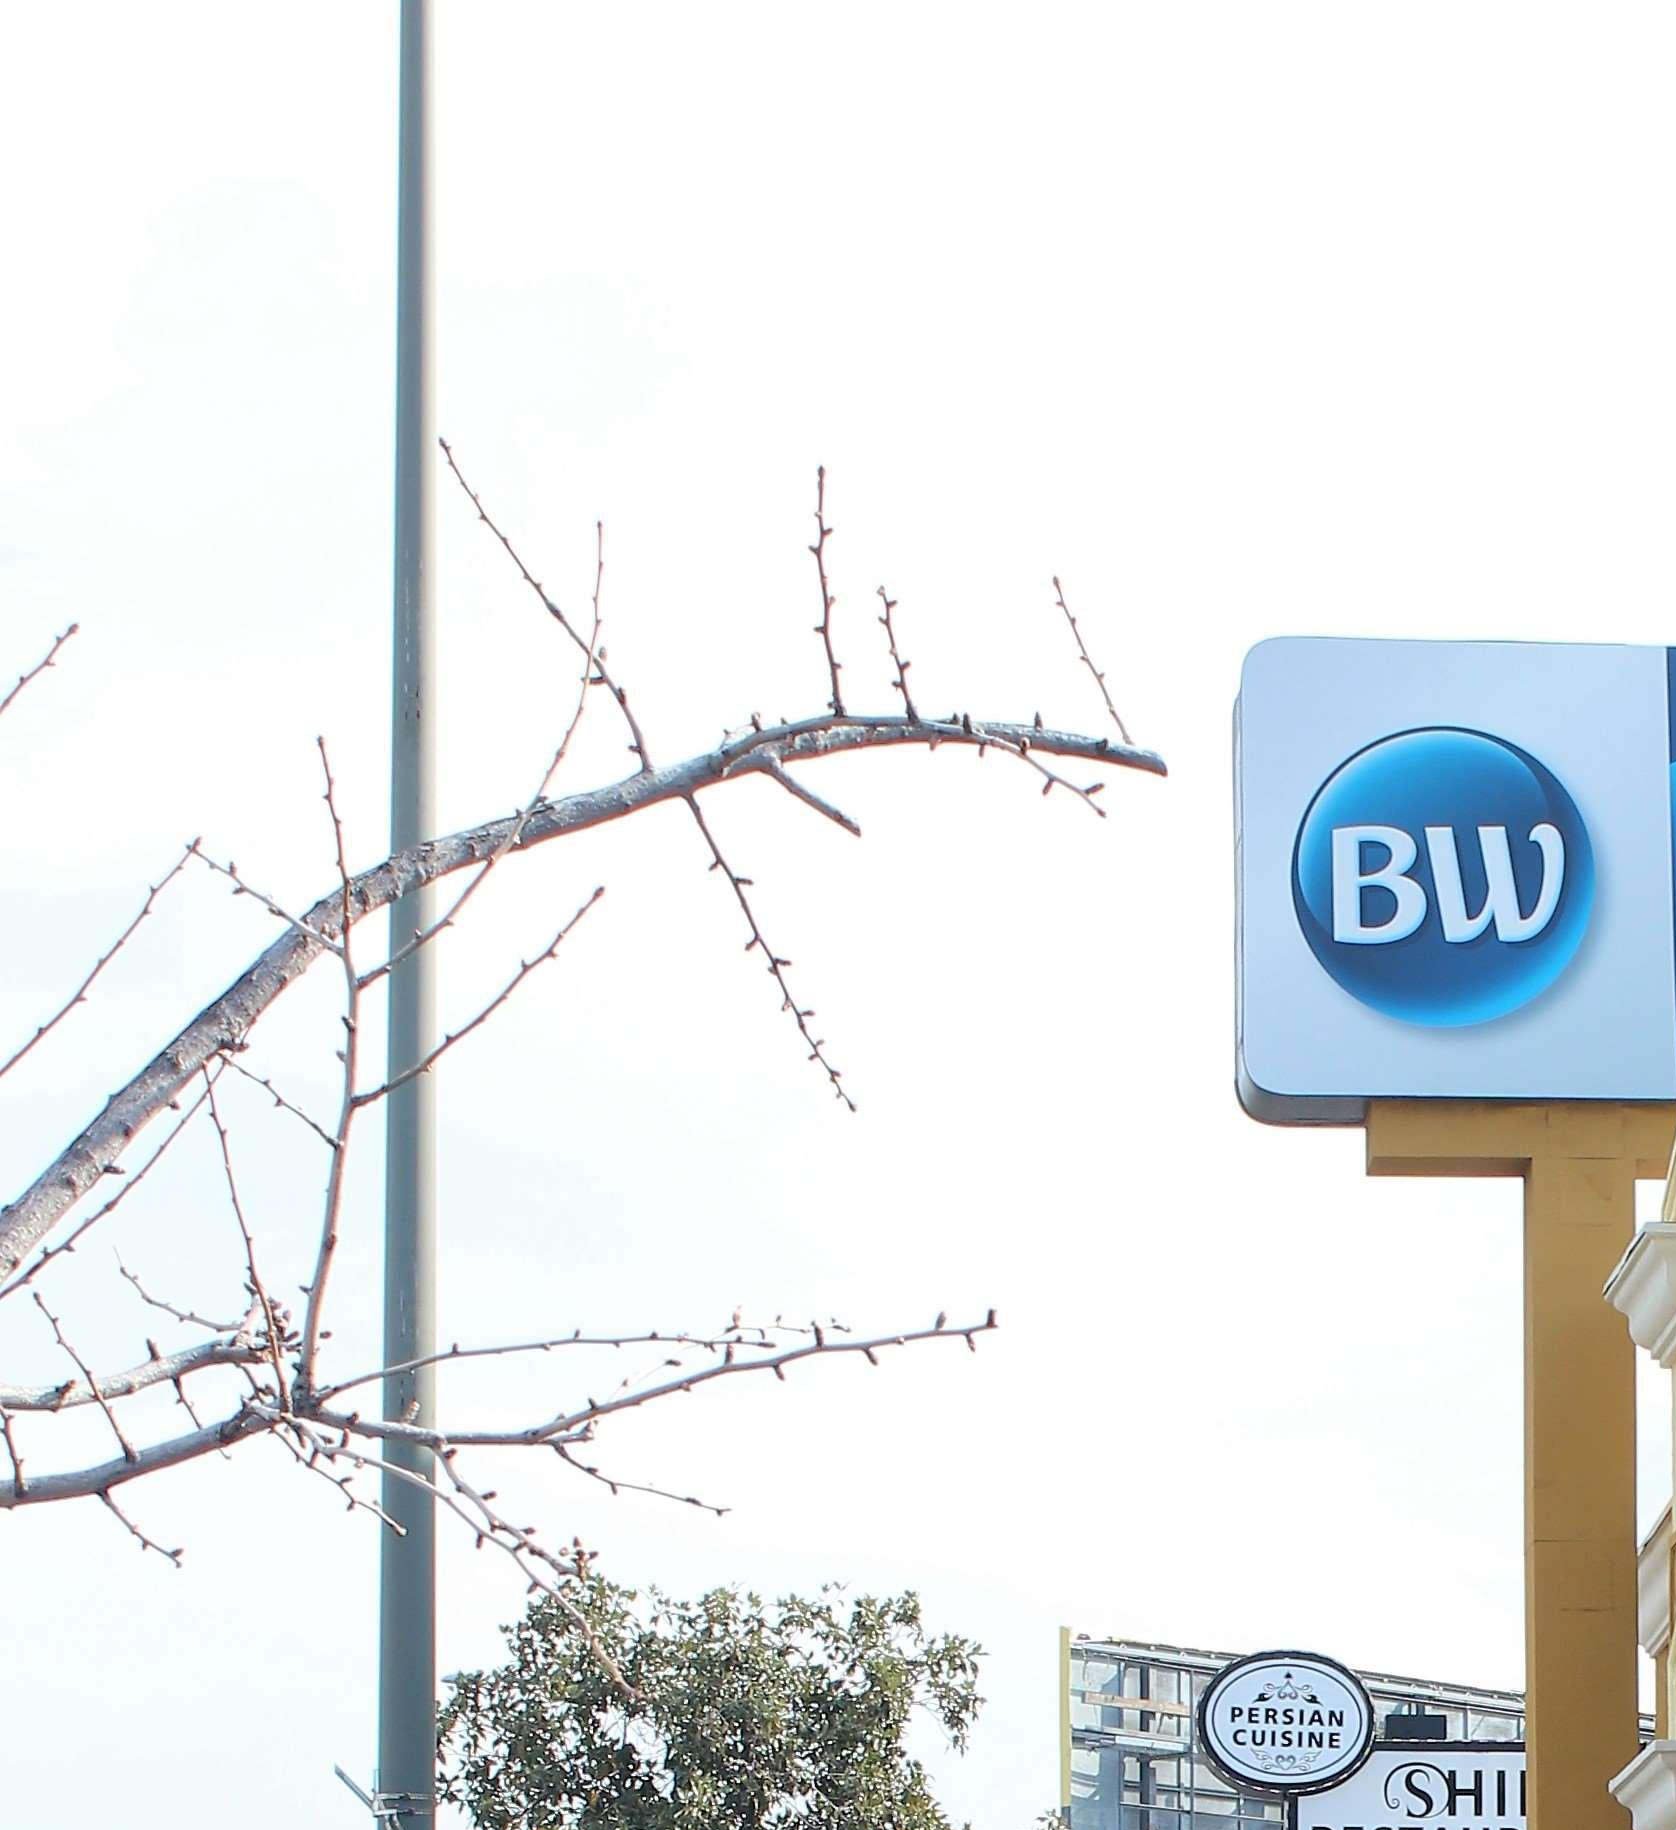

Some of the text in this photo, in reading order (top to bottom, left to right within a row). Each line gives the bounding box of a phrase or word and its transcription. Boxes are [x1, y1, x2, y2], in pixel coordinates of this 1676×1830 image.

[1331, 823, 1566, 945] BW
[1230, 1706, 1344, 1727] PERSIAN
[1232, 1729, 1342, 1749] CUISINE
